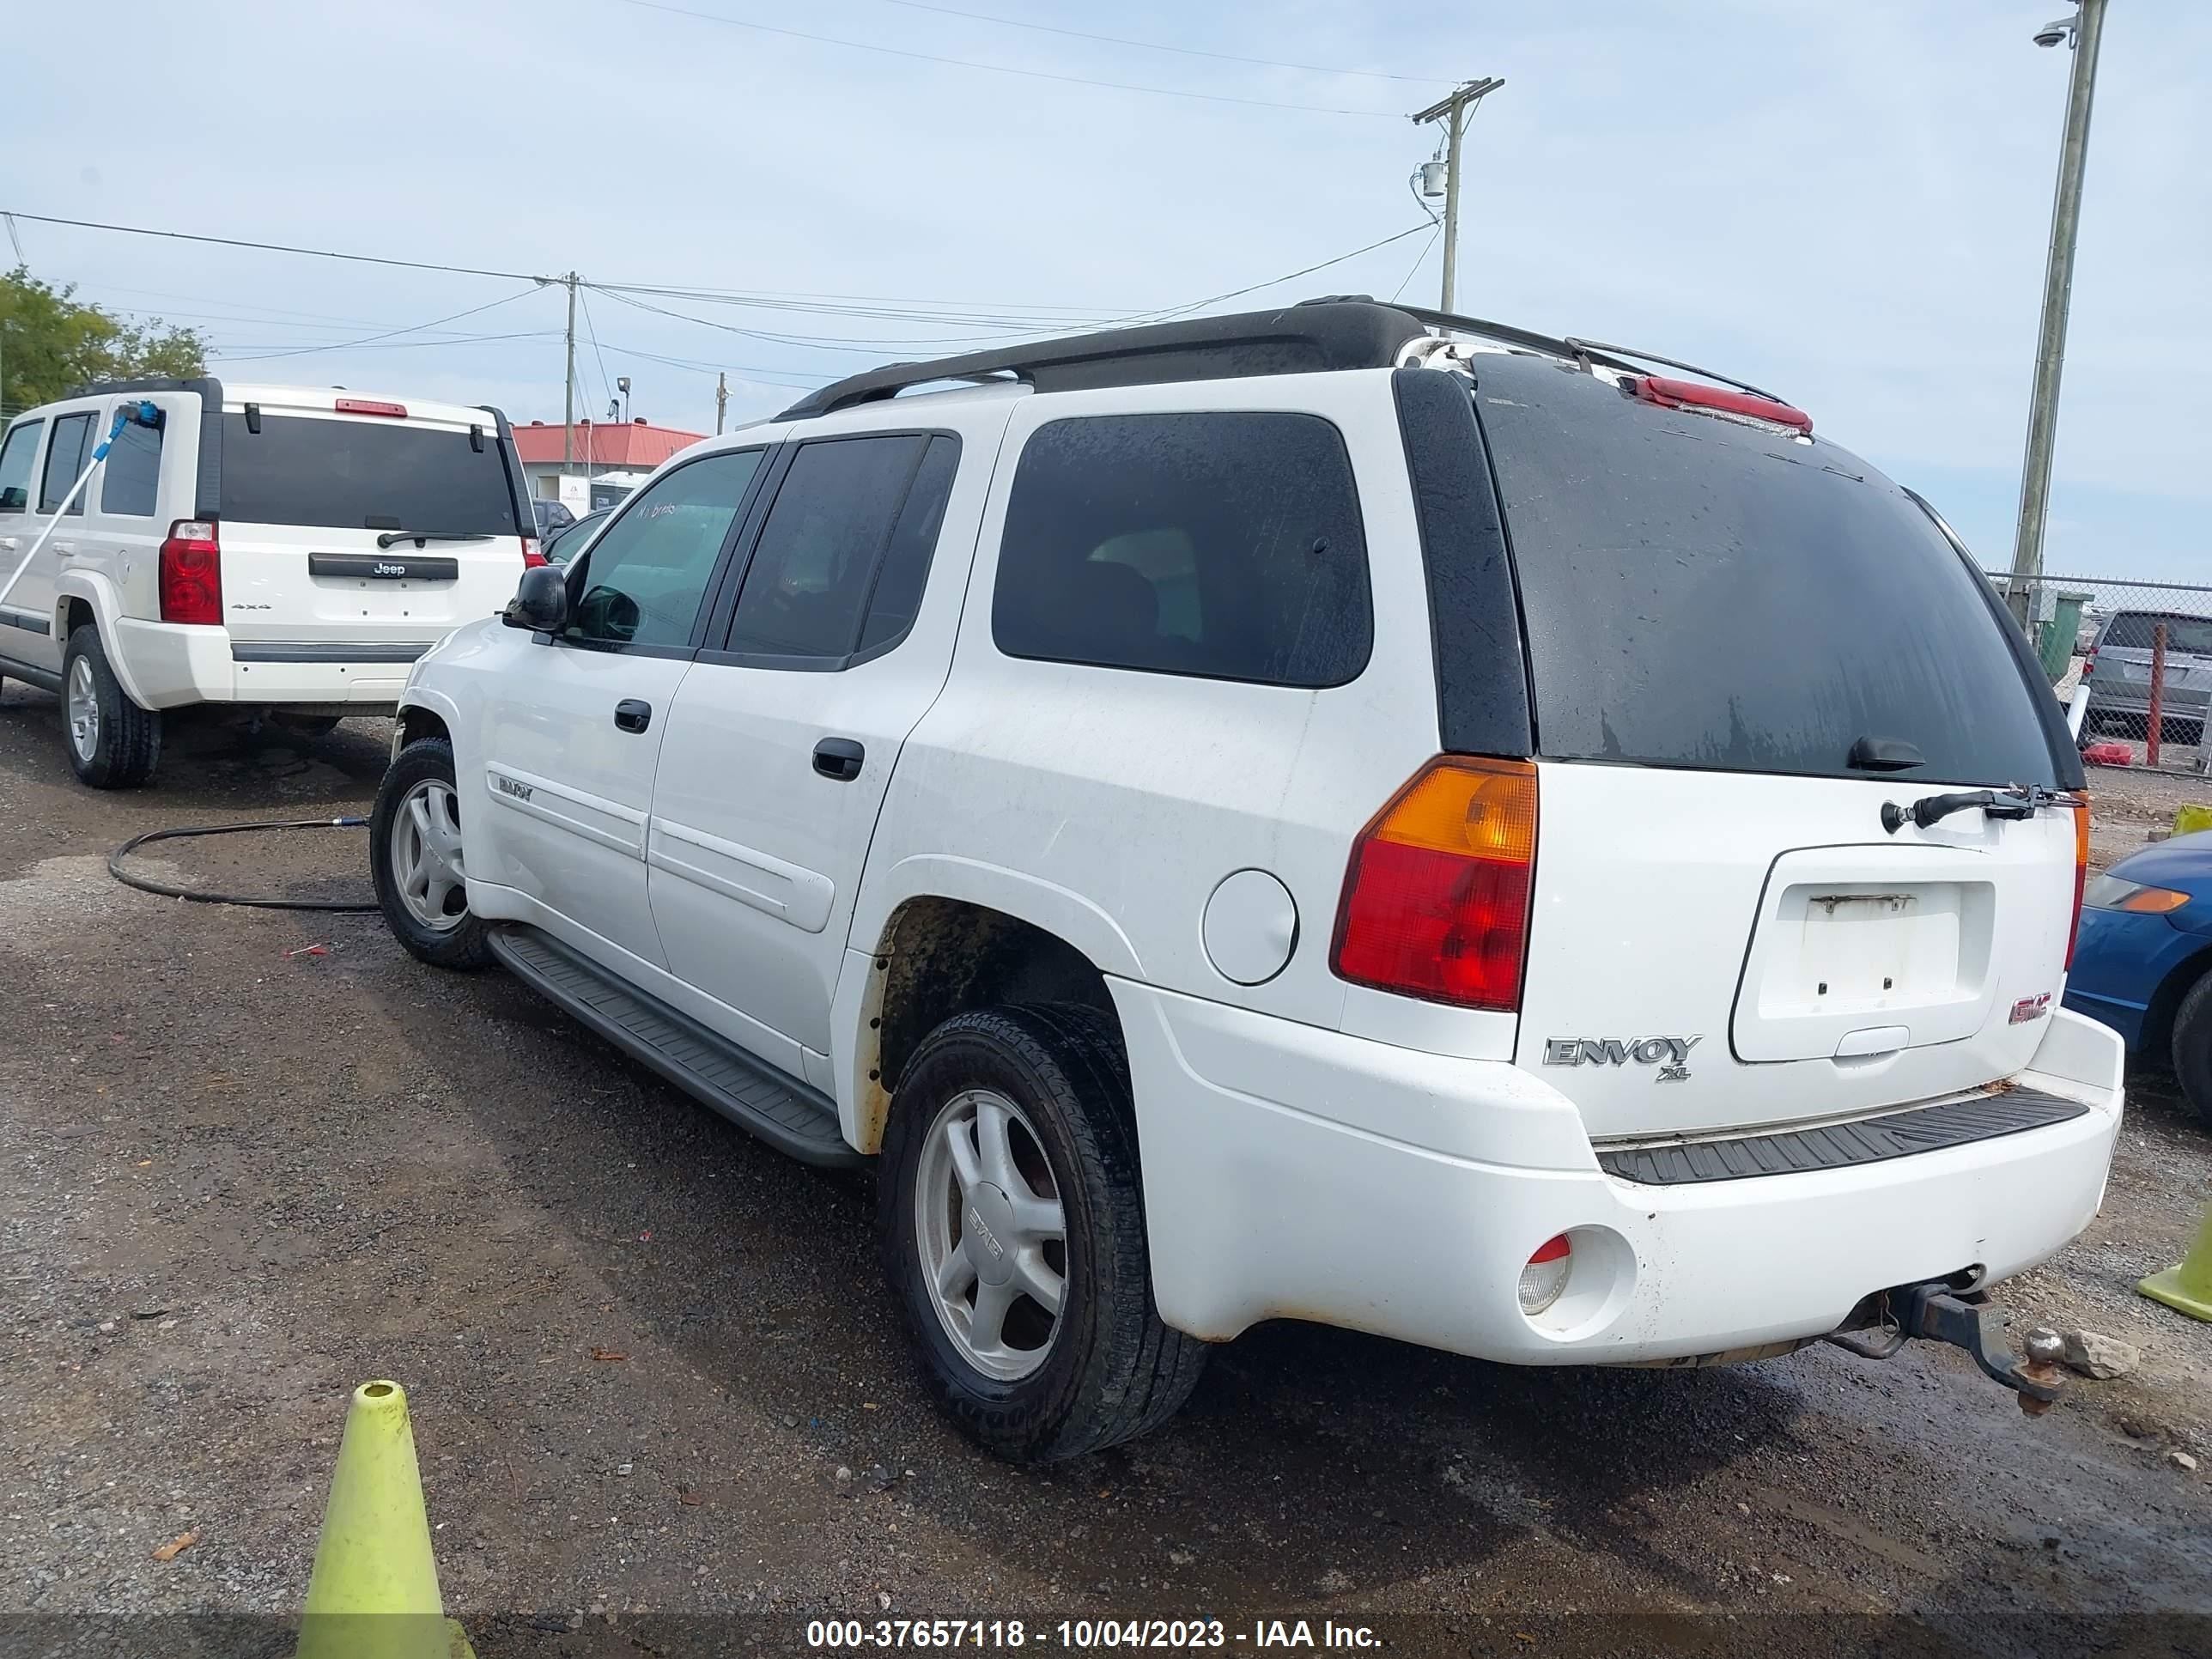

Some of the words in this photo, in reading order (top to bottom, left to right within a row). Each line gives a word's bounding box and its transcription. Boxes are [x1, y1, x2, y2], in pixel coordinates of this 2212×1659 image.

[374, 562, 405, 576] Jeep
[2008, 992, 2051, 1025] GMC
[1542, 1033, 1705, 1067] ENVOY
[1655, 1065, 1692, 1083] XL
[968, 1206, 1004, 1261] GMC
